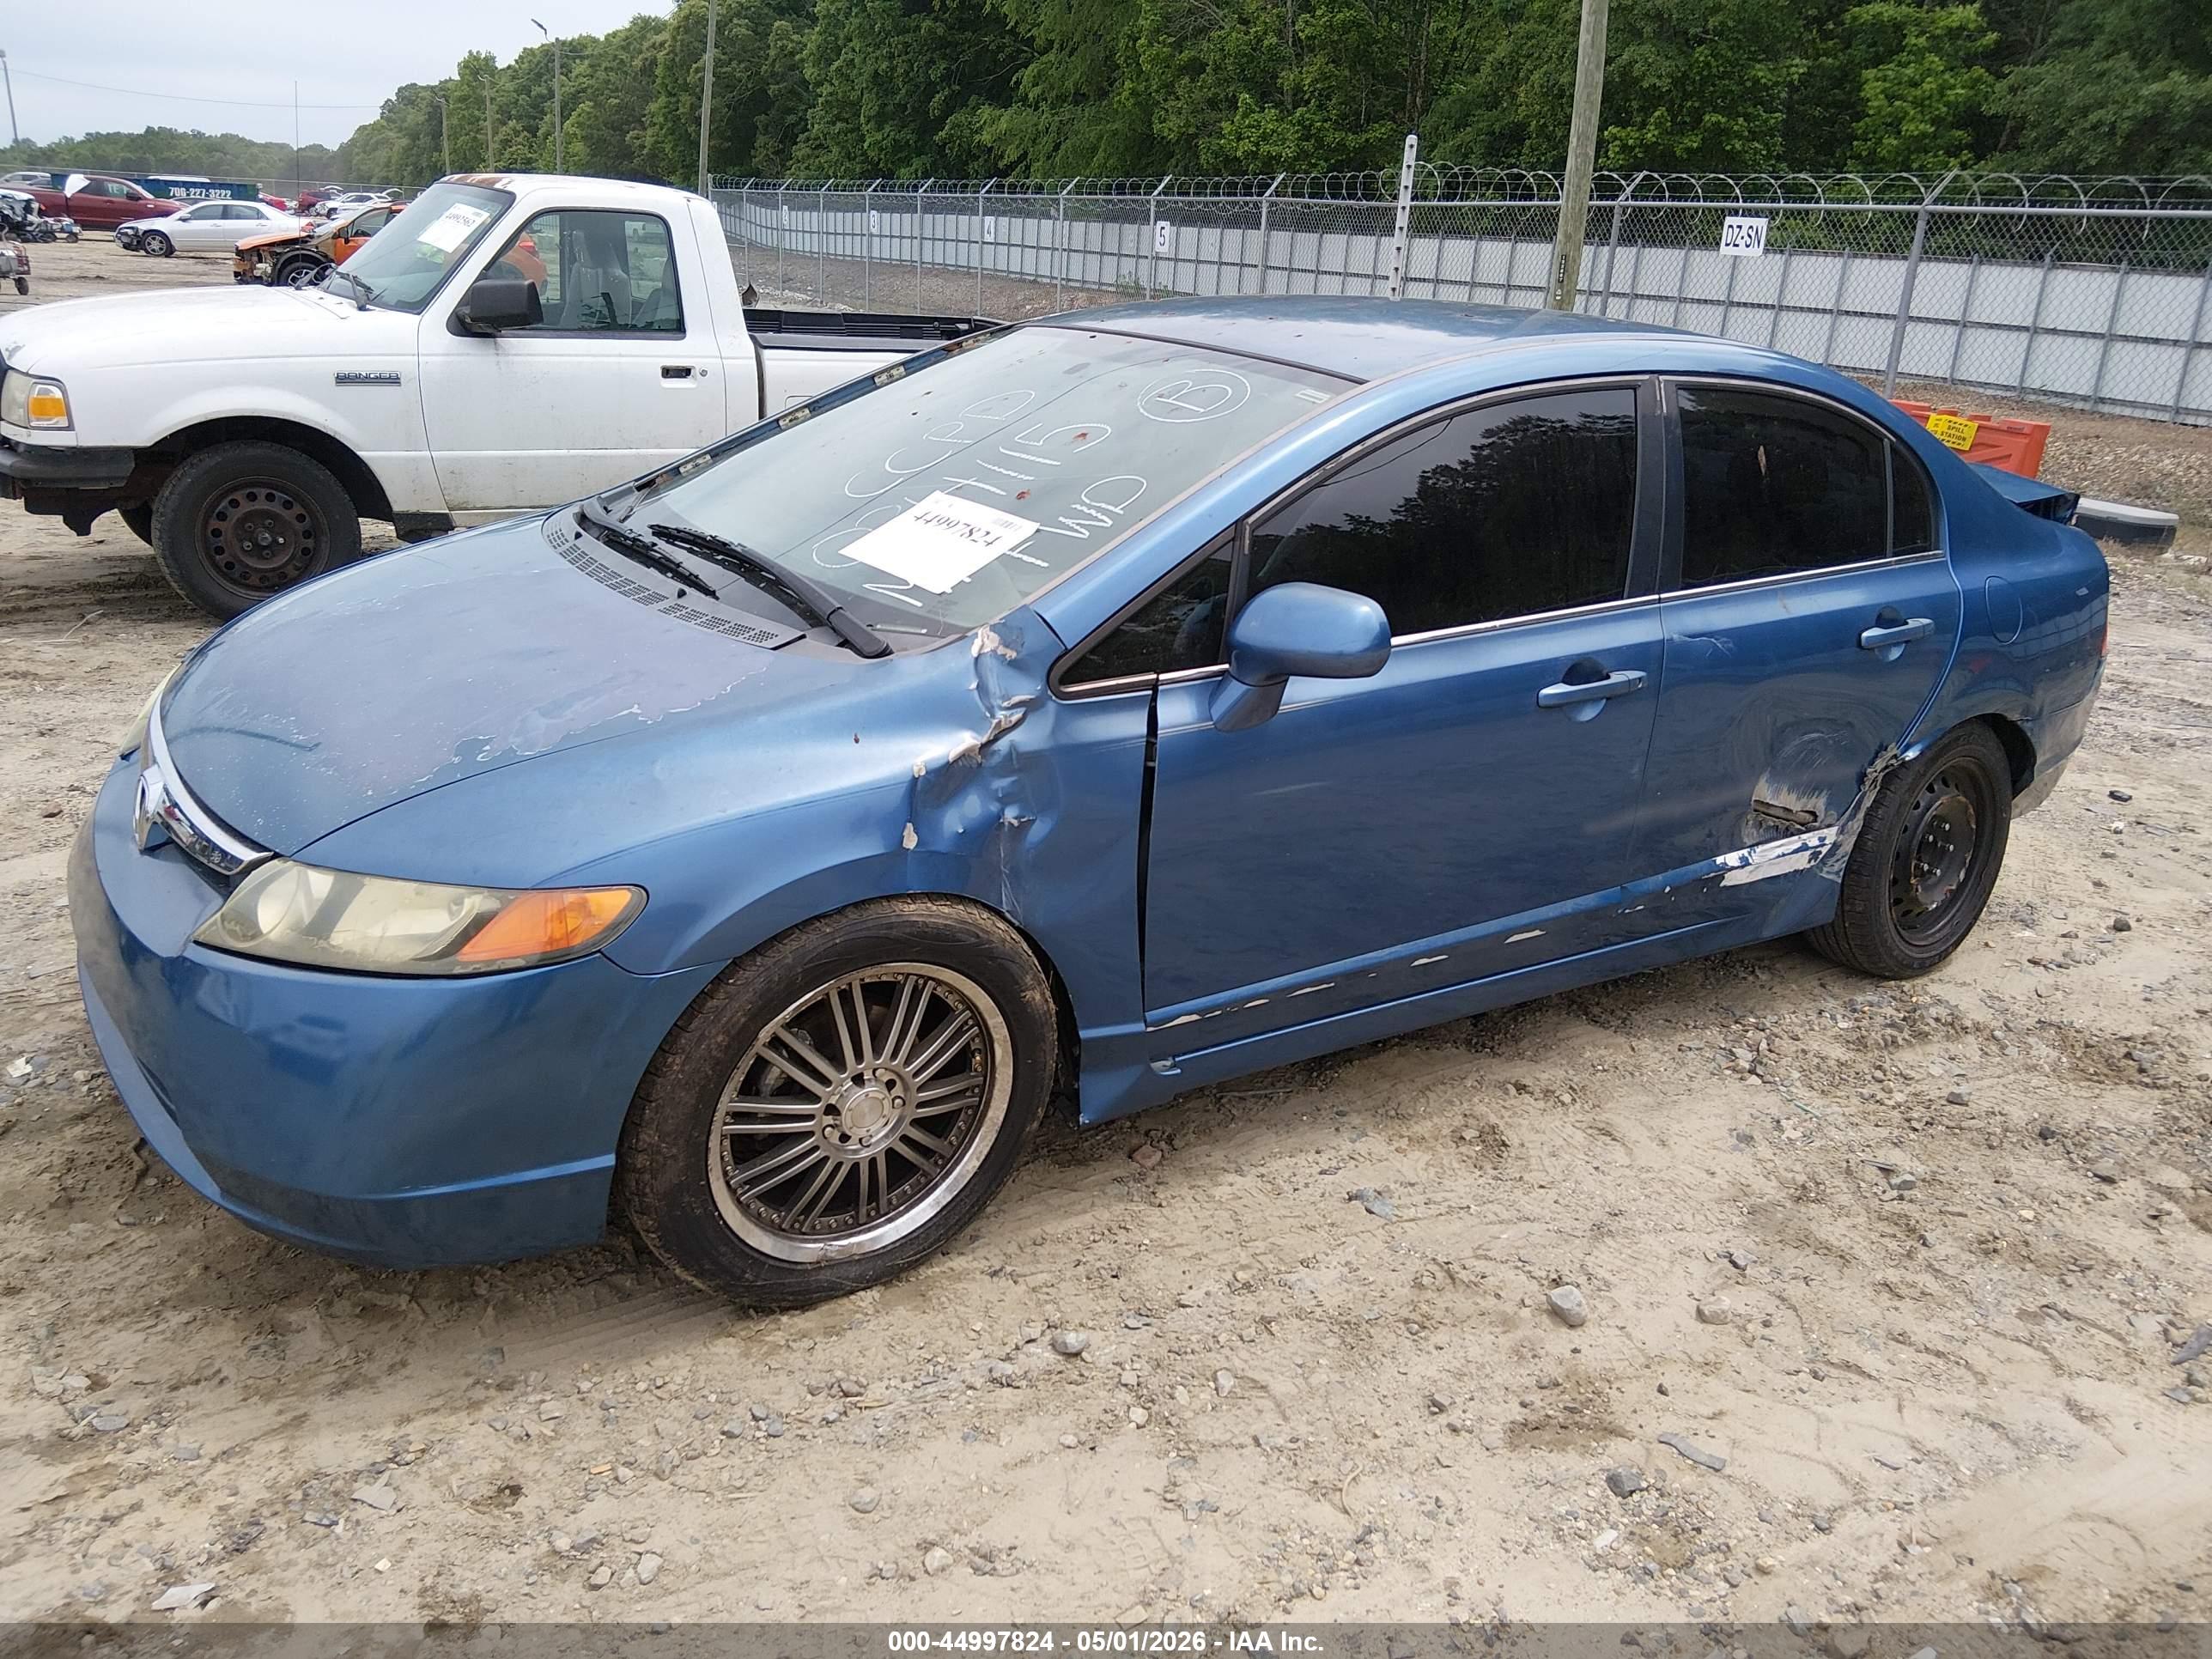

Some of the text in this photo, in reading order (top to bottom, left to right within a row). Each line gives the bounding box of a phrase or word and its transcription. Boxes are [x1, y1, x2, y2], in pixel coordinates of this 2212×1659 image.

[871, 214, 877, 229] 3
[987, 222, 993, 237] 4
[1158, 226, 1167, 247] 5
[1724, 224, 1765, 249] DZ-SN
[1940, 431, 1967, 442] STATION
[1947, 425, 1965, 434] SPILL
[845, 390, 1036, 498] CCPD
[914, 511, 1004, 547] 44997824
